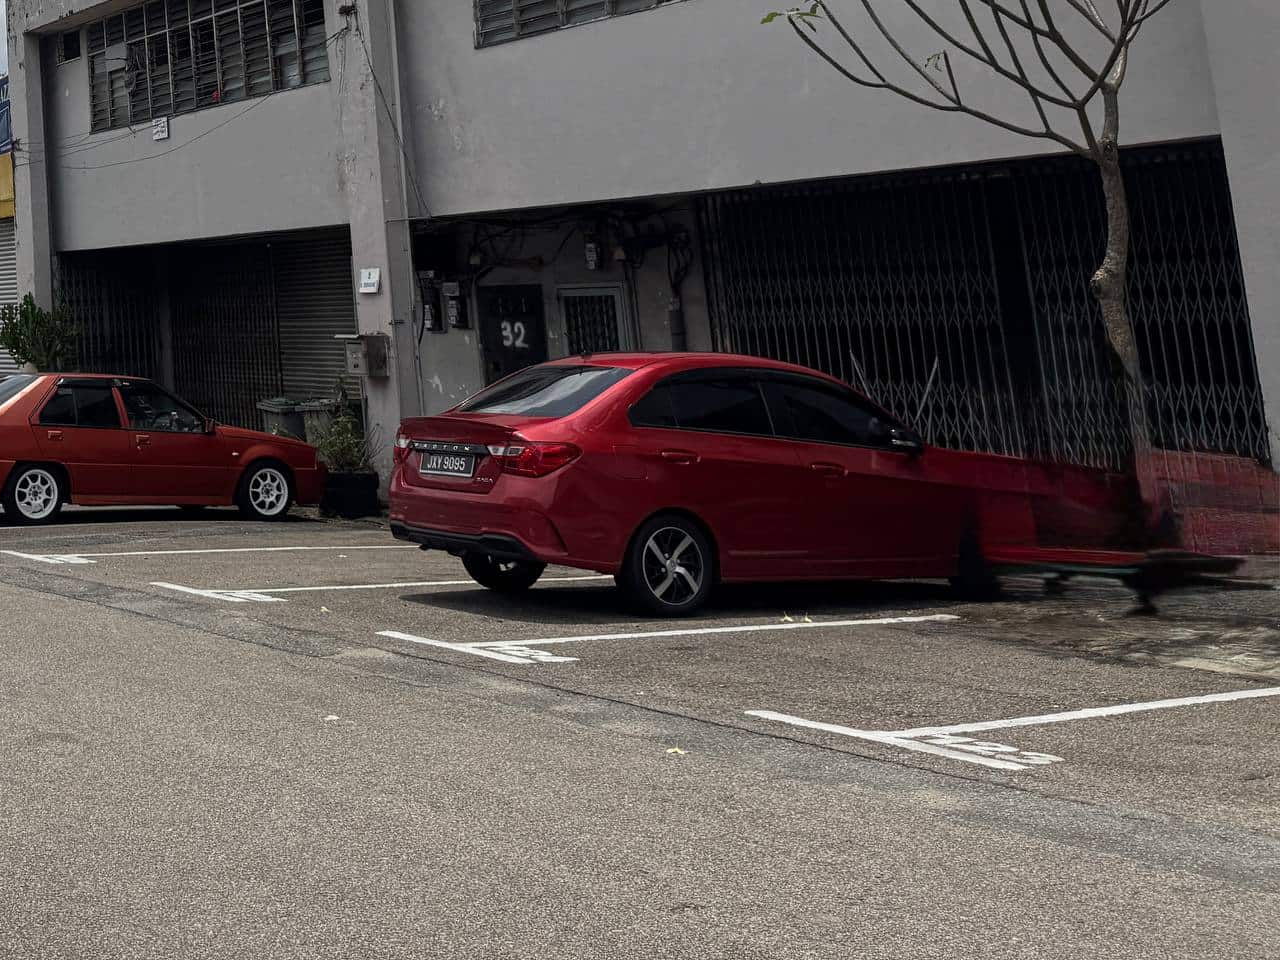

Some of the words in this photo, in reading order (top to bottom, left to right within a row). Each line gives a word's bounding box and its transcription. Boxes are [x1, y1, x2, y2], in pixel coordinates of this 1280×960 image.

[501, 321, 528, 348] 32
[427, 456, 443, 469] JXY
[443, 456, 466, 471] 9095
